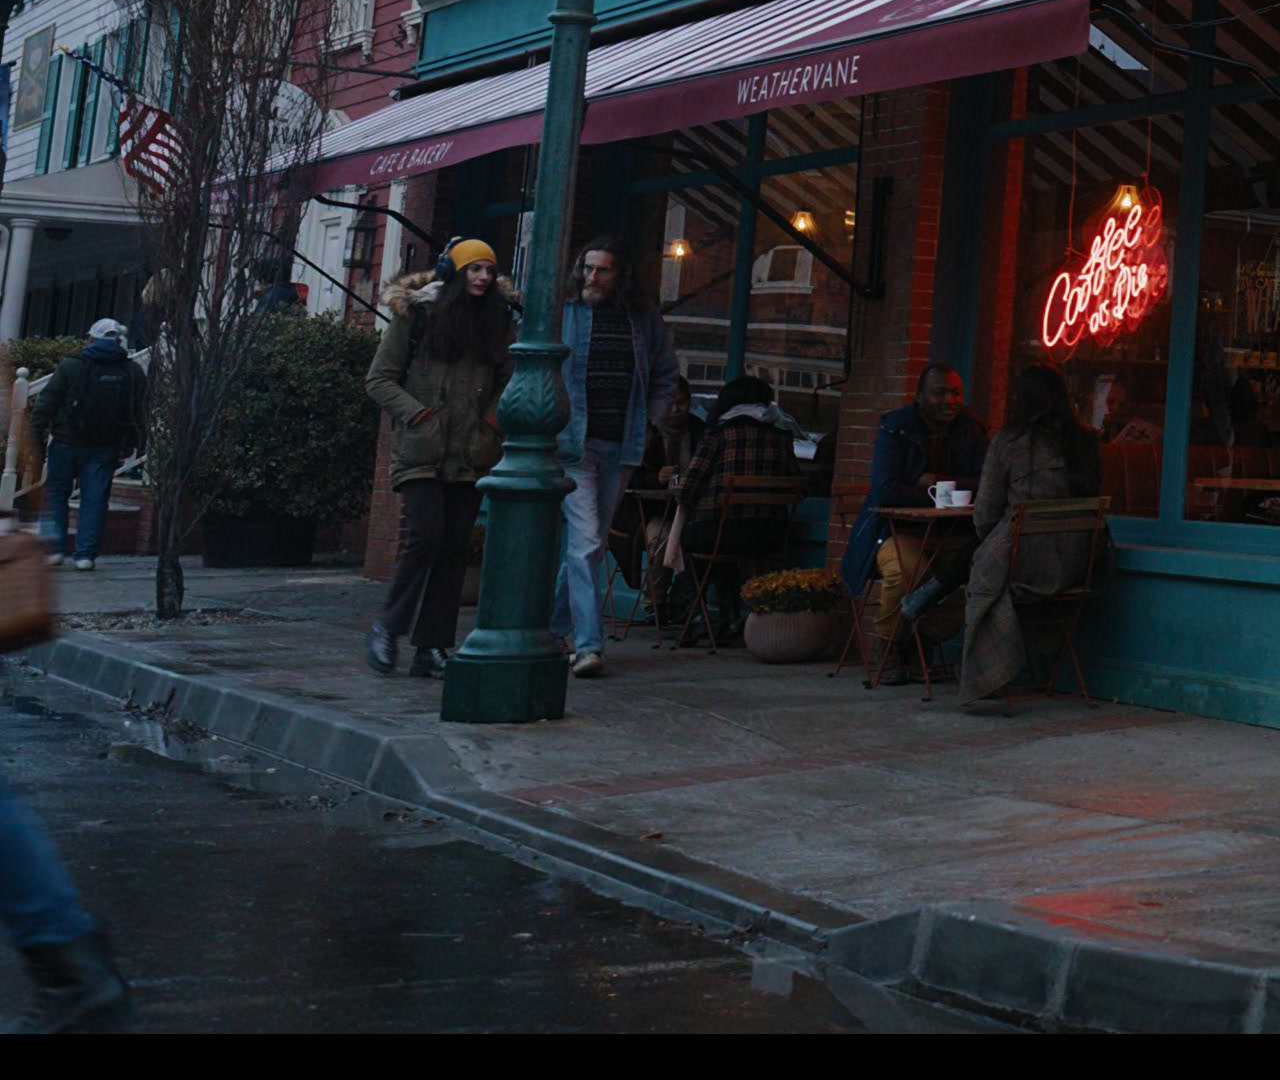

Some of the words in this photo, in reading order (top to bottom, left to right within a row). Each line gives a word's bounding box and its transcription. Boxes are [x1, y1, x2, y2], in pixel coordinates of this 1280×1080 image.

[737, 55, 860, 104] WEATHERVANE
[369, 152, 400, 175] CAFE
[406, 141, 454, 169] BAKERY
